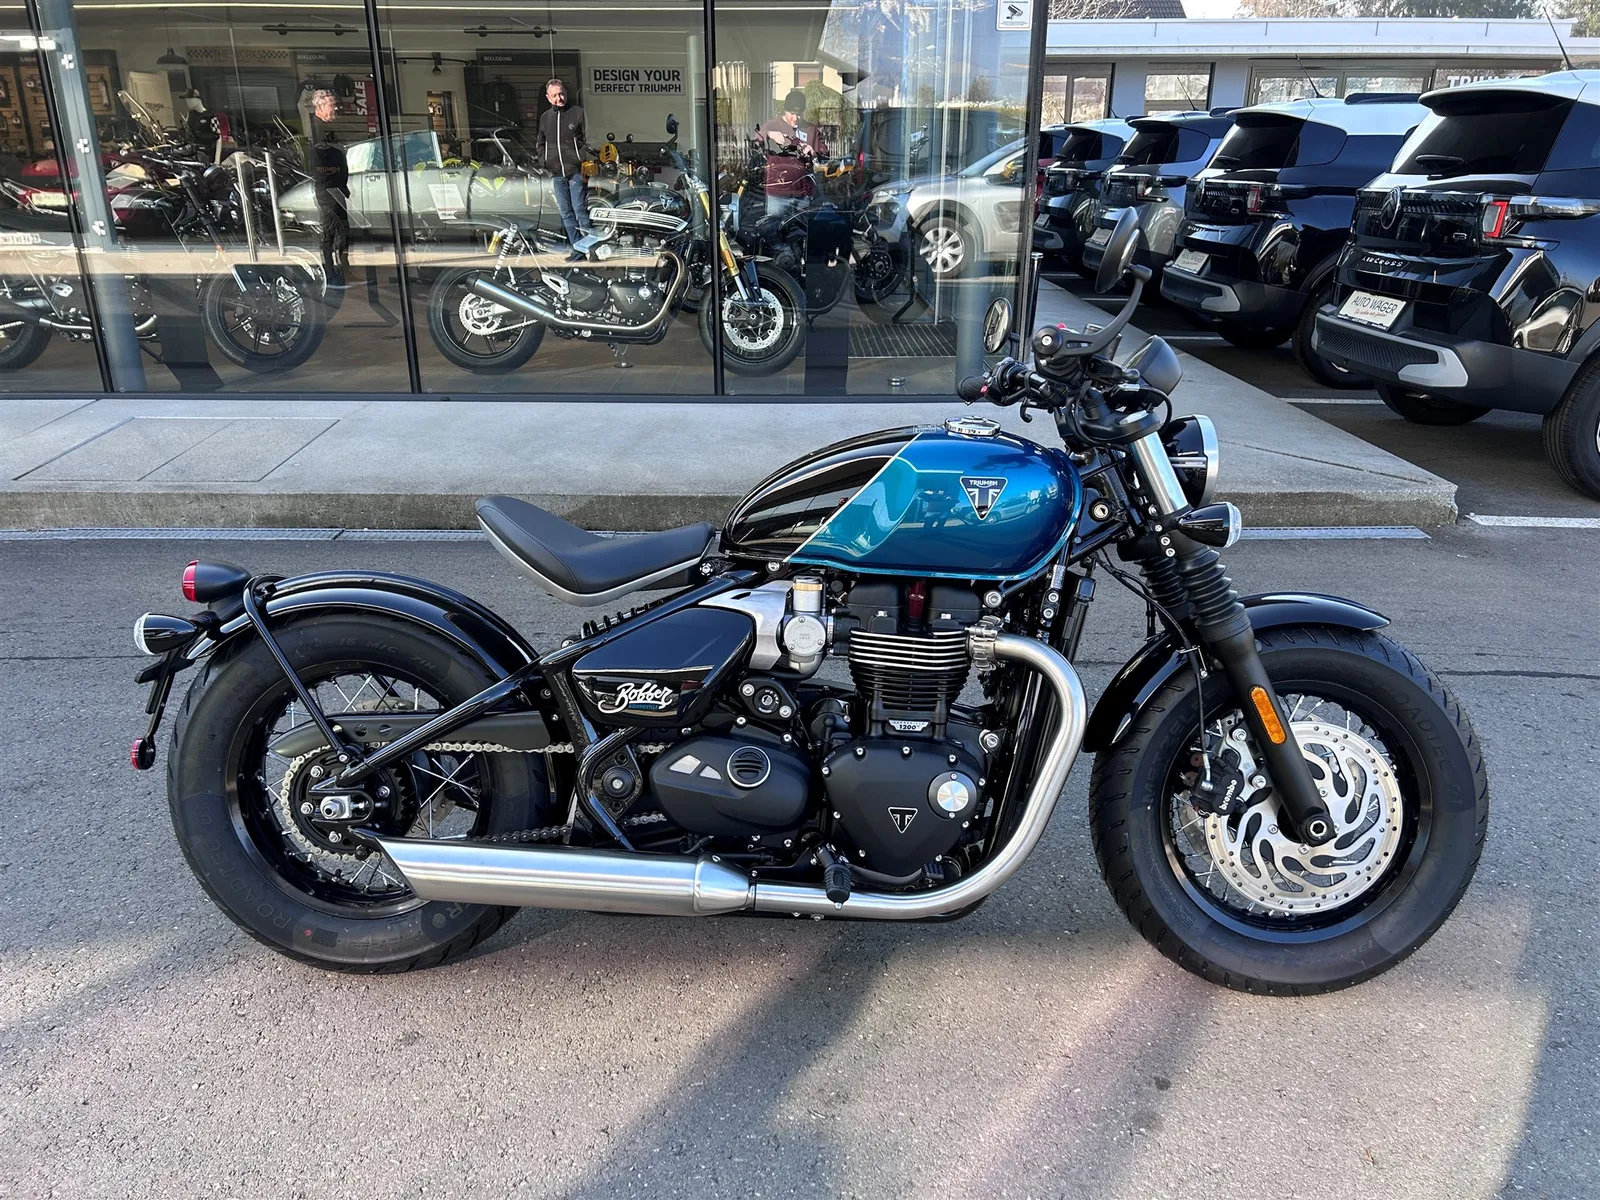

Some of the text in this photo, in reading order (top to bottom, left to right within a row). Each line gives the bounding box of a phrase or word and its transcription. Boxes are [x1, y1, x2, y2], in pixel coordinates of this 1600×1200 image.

[593, 69, 681, 81] DESIGN YOUR
[594, 83, 681, 92] PERFECT TRIUMPH
[354, 81, 368, 116] SALE
[1351, 295, 1371, 309] AUTO
[1368, 299, 1398, 315] WÄGER
[969, 479, 998, 488] TRIUMPH
[597, 681, 673, 714] Bobber
[1219, 779, 1238, 810] brembo
